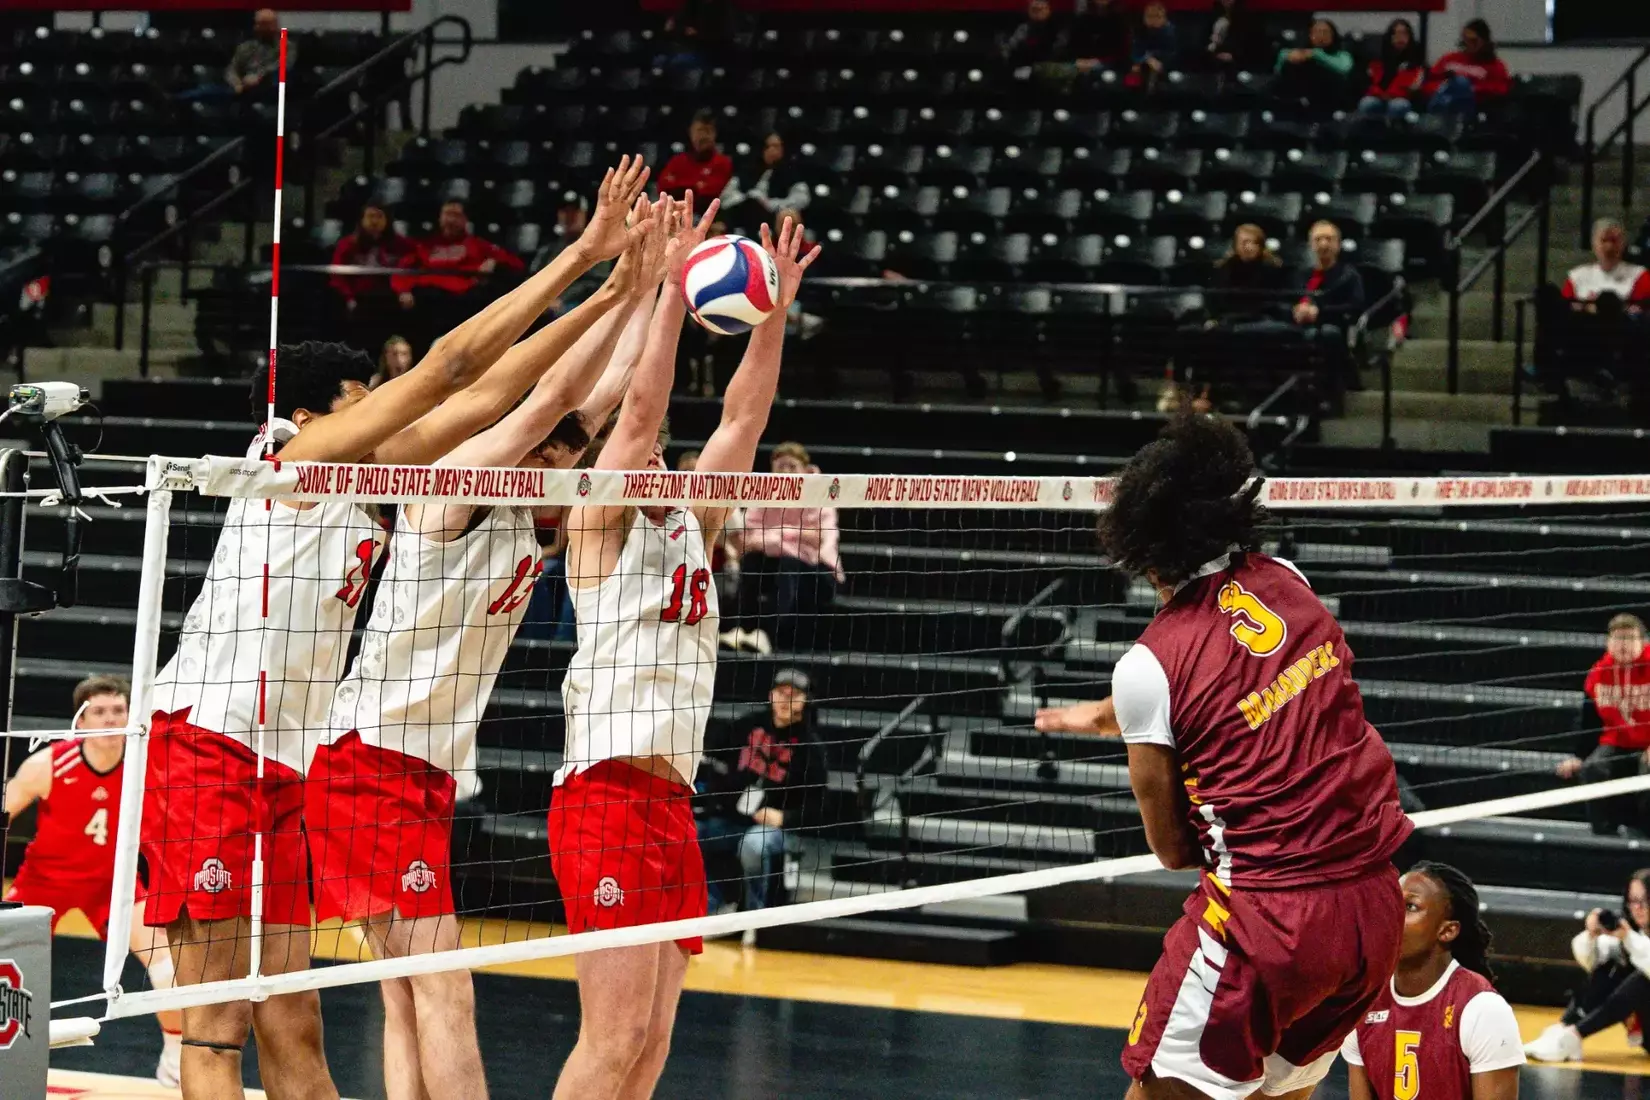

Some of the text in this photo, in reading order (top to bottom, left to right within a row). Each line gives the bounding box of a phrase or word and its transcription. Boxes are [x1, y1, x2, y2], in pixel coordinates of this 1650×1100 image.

[293, 465, 334, 493] HOME
[336, 465, 353, 494] OF
[355, 466, 389, 495] OHIO
[391, 467, 431, 496] STATE
[432, 468, 473, 496] MEN'S
[474, 469, 545, 498] VOLLEYBALL
[623, 473, 687, 498] THREE-TIME
[689, 474, 739, 500] NATIONAL
[741, 475, 804, 501] CHAMPIONS
[865, 478, 894, 501] HOME
[895, 478, 908, 501] OF
[908, 478, 932, 501] OHIO
[933, 479, 960, 501] STATE
[961, 479, 990, 501] MEN'S
[990, 480, 1040, 502] VOLLEYBALL
[660, 563, 710, 626] 18
[84, 808, 109, 846] 4
[1393, 1030, 1421, 1100] 5
